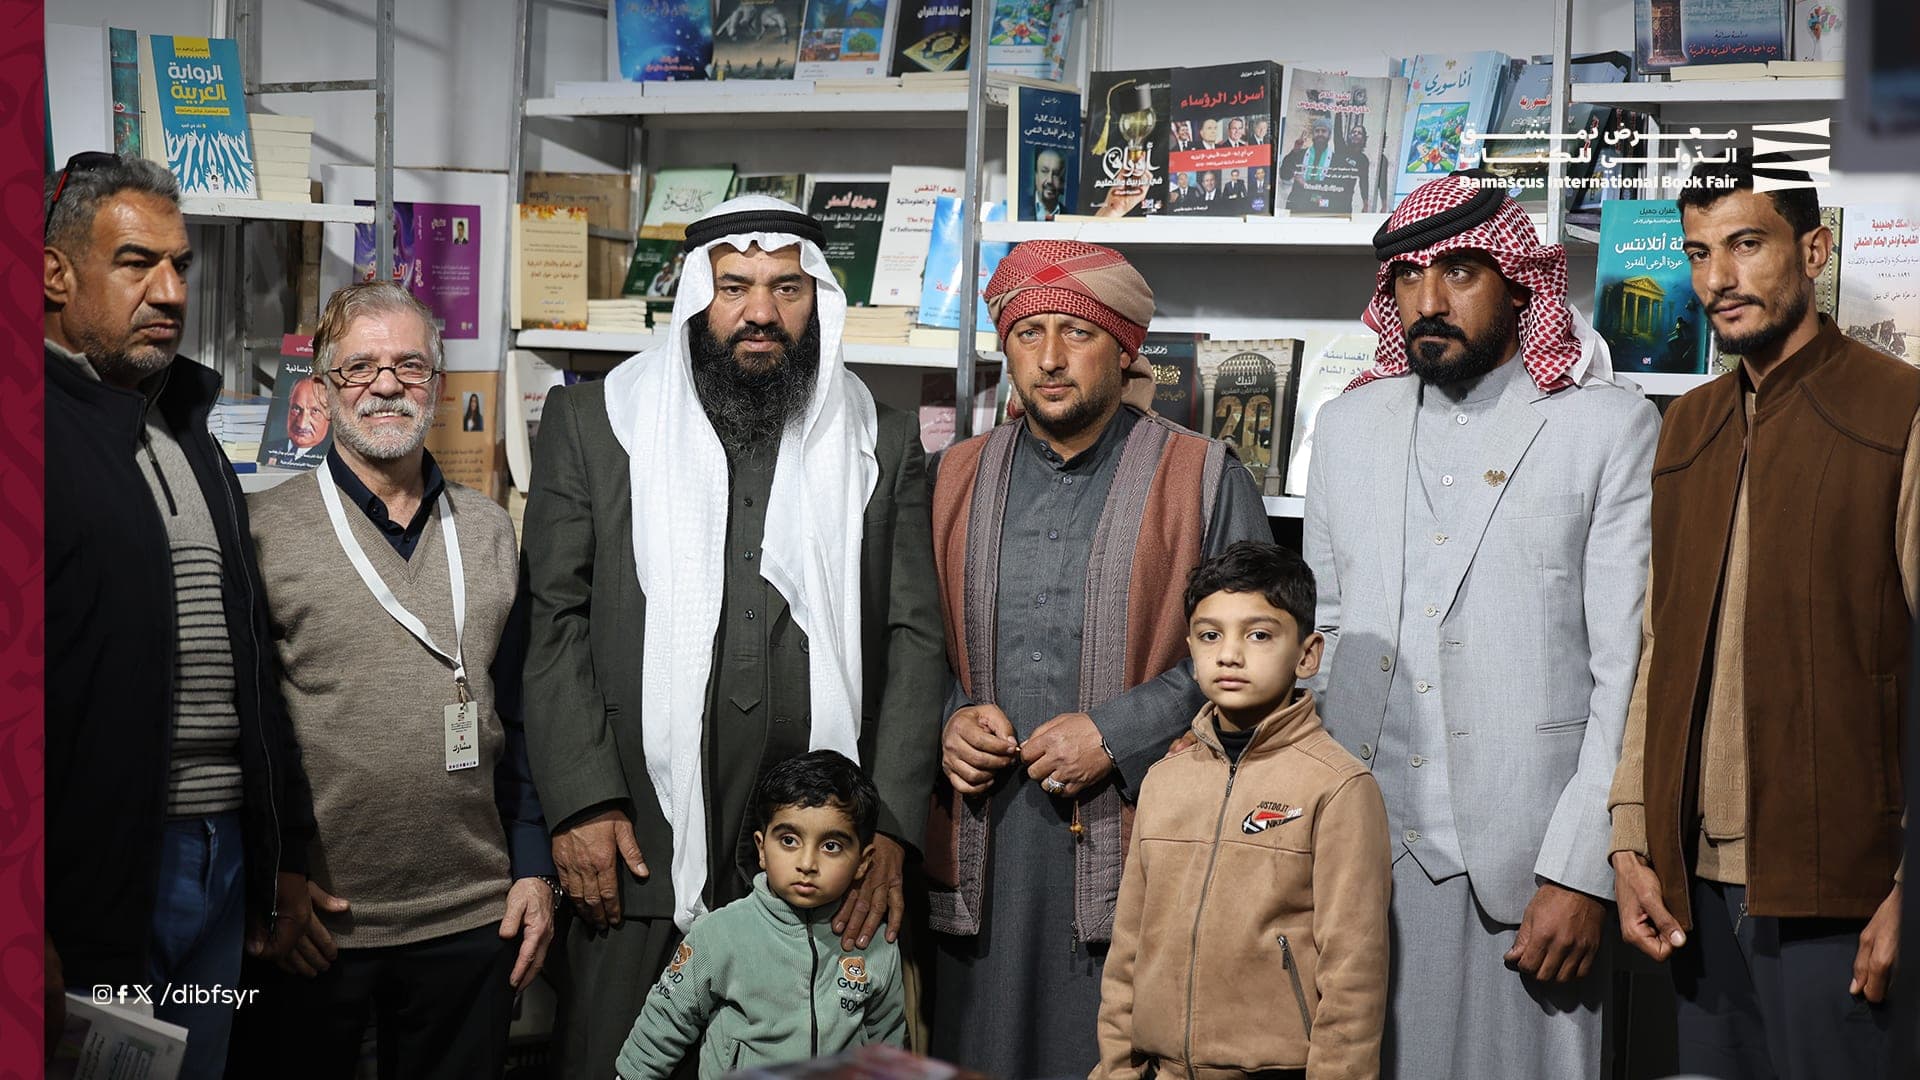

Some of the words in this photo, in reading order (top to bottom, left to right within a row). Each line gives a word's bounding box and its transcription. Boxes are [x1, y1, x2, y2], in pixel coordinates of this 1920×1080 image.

[168, 62, 223, 84] الرواية
[1458, 67, 1473, 88] أنا
[1424, 73, 1457, 96] سوري
[171, 81, 227, 104] العربية
[1180, 92, 1227, 108] الرؤساء
[1229, 85, 1265, 105] أسرار
[1519, 95, 1552, 110] لسورية
[914, 184, 940, 194] النفس
[1614, 232, 1667, 254] أتلانتس
[1323, 350, 1369, 361] الغساسنة
[285, 363, 313, 376] لإنسانية
[1318, 365, 1346, 375] الشام
[1350, 367, 1364, 375] لاد
[1234, 375, 1257, 388] النبك
[452, 742, 472, 754] مشارك
